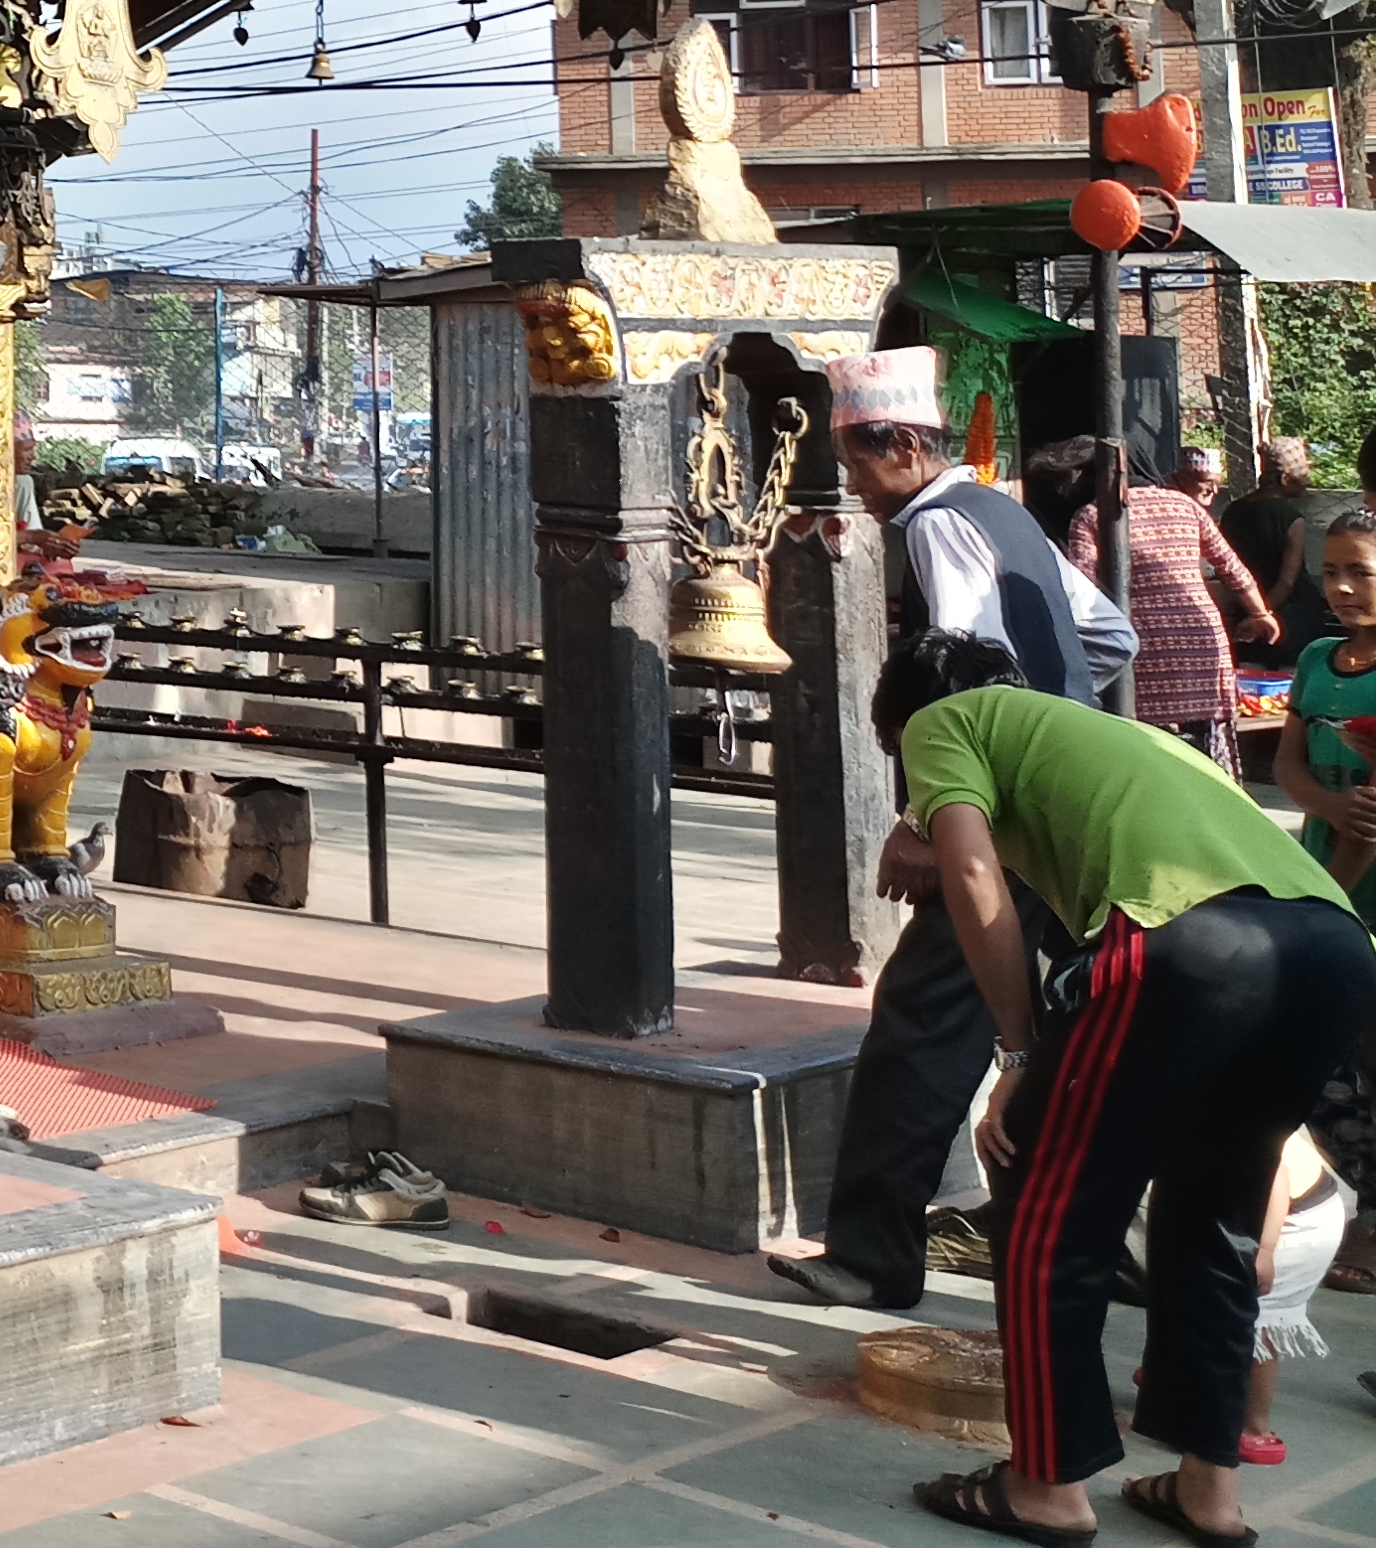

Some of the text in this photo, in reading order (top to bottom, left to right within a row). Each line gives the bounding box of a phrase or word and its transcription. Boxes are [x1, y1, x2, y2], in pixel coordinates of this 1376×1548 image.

[1263, 97, 1306, 121] Open
[1260, 126, 1303, 154] B.Ed.
[1267, 179, 1304, 191] COLLEGE
[1315, 192, 1336, 202] CA
